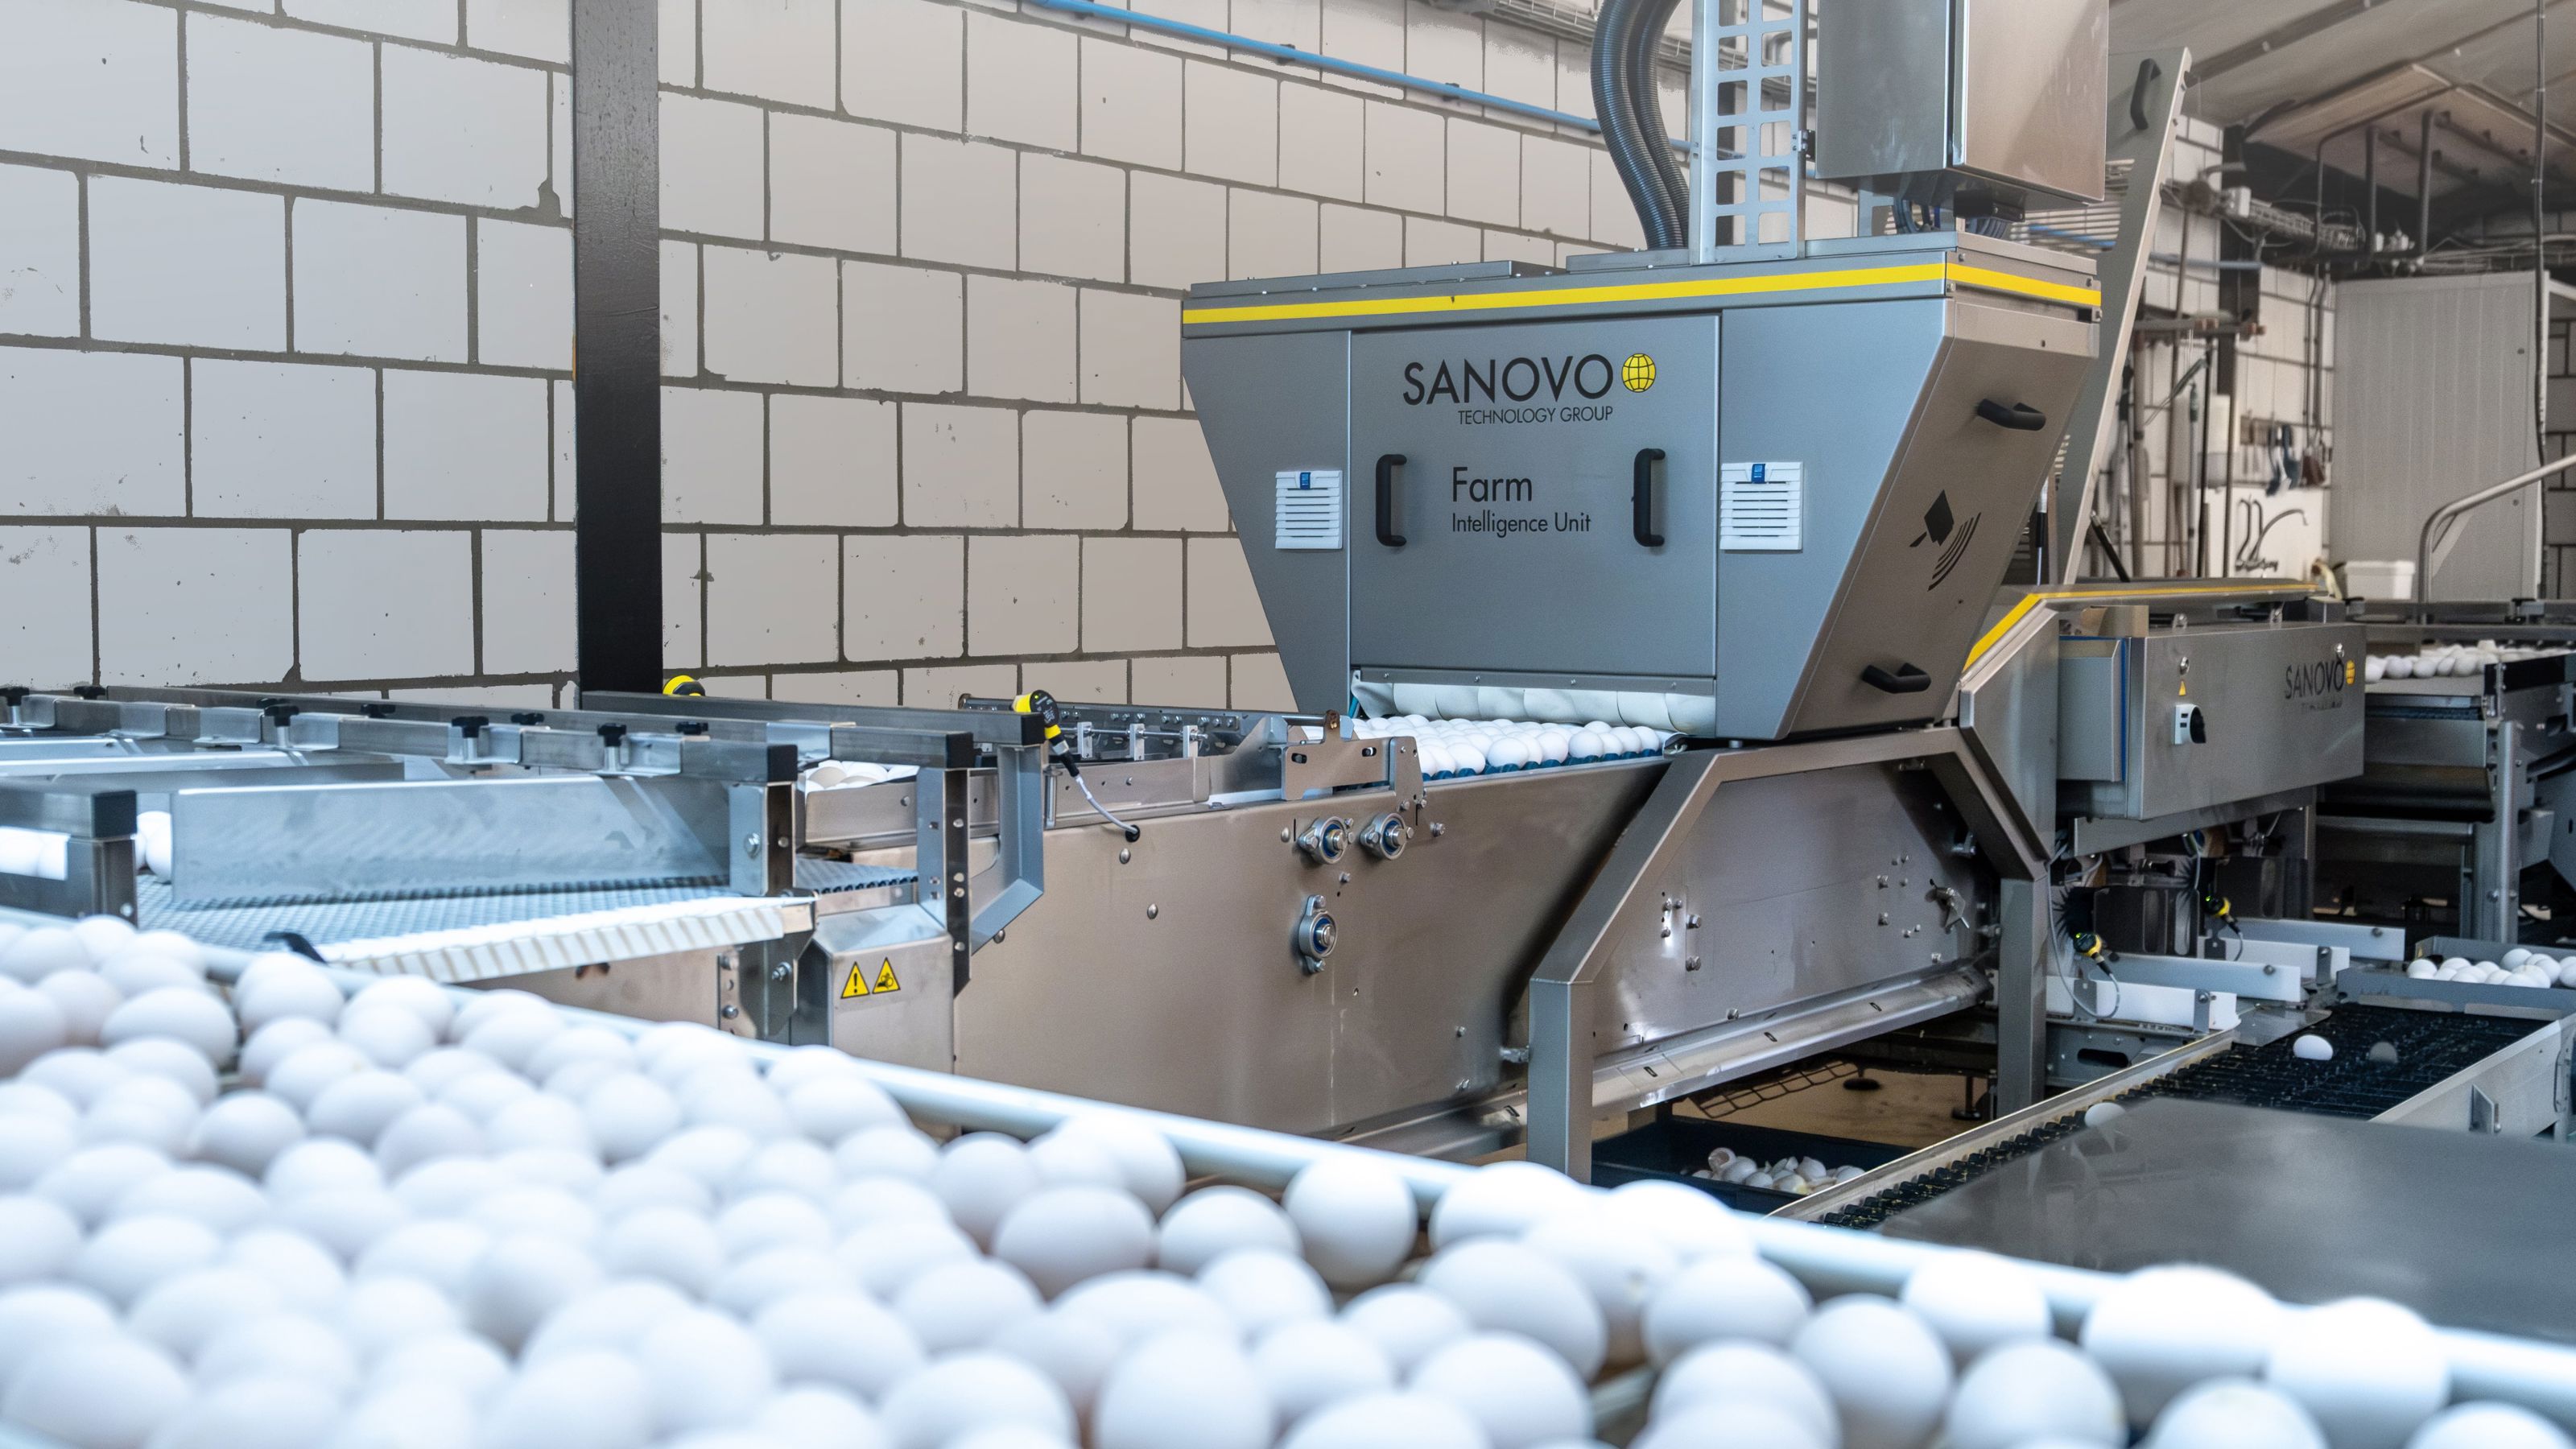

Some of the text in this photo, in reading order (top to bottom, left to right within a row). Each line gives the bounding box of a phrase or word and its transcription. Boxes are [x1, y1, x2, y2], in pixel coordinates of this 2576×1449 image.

[1402, 353, 1614, 406] SANOVO
[1458, 406, 1613, 425] TECHNOLOGY GROUP
[1452, 466, 1533, 502] Farm
[1452, 510, 1591, 539] Intelligence Unit
[2285, 660, 2344, 700] SANOVO
